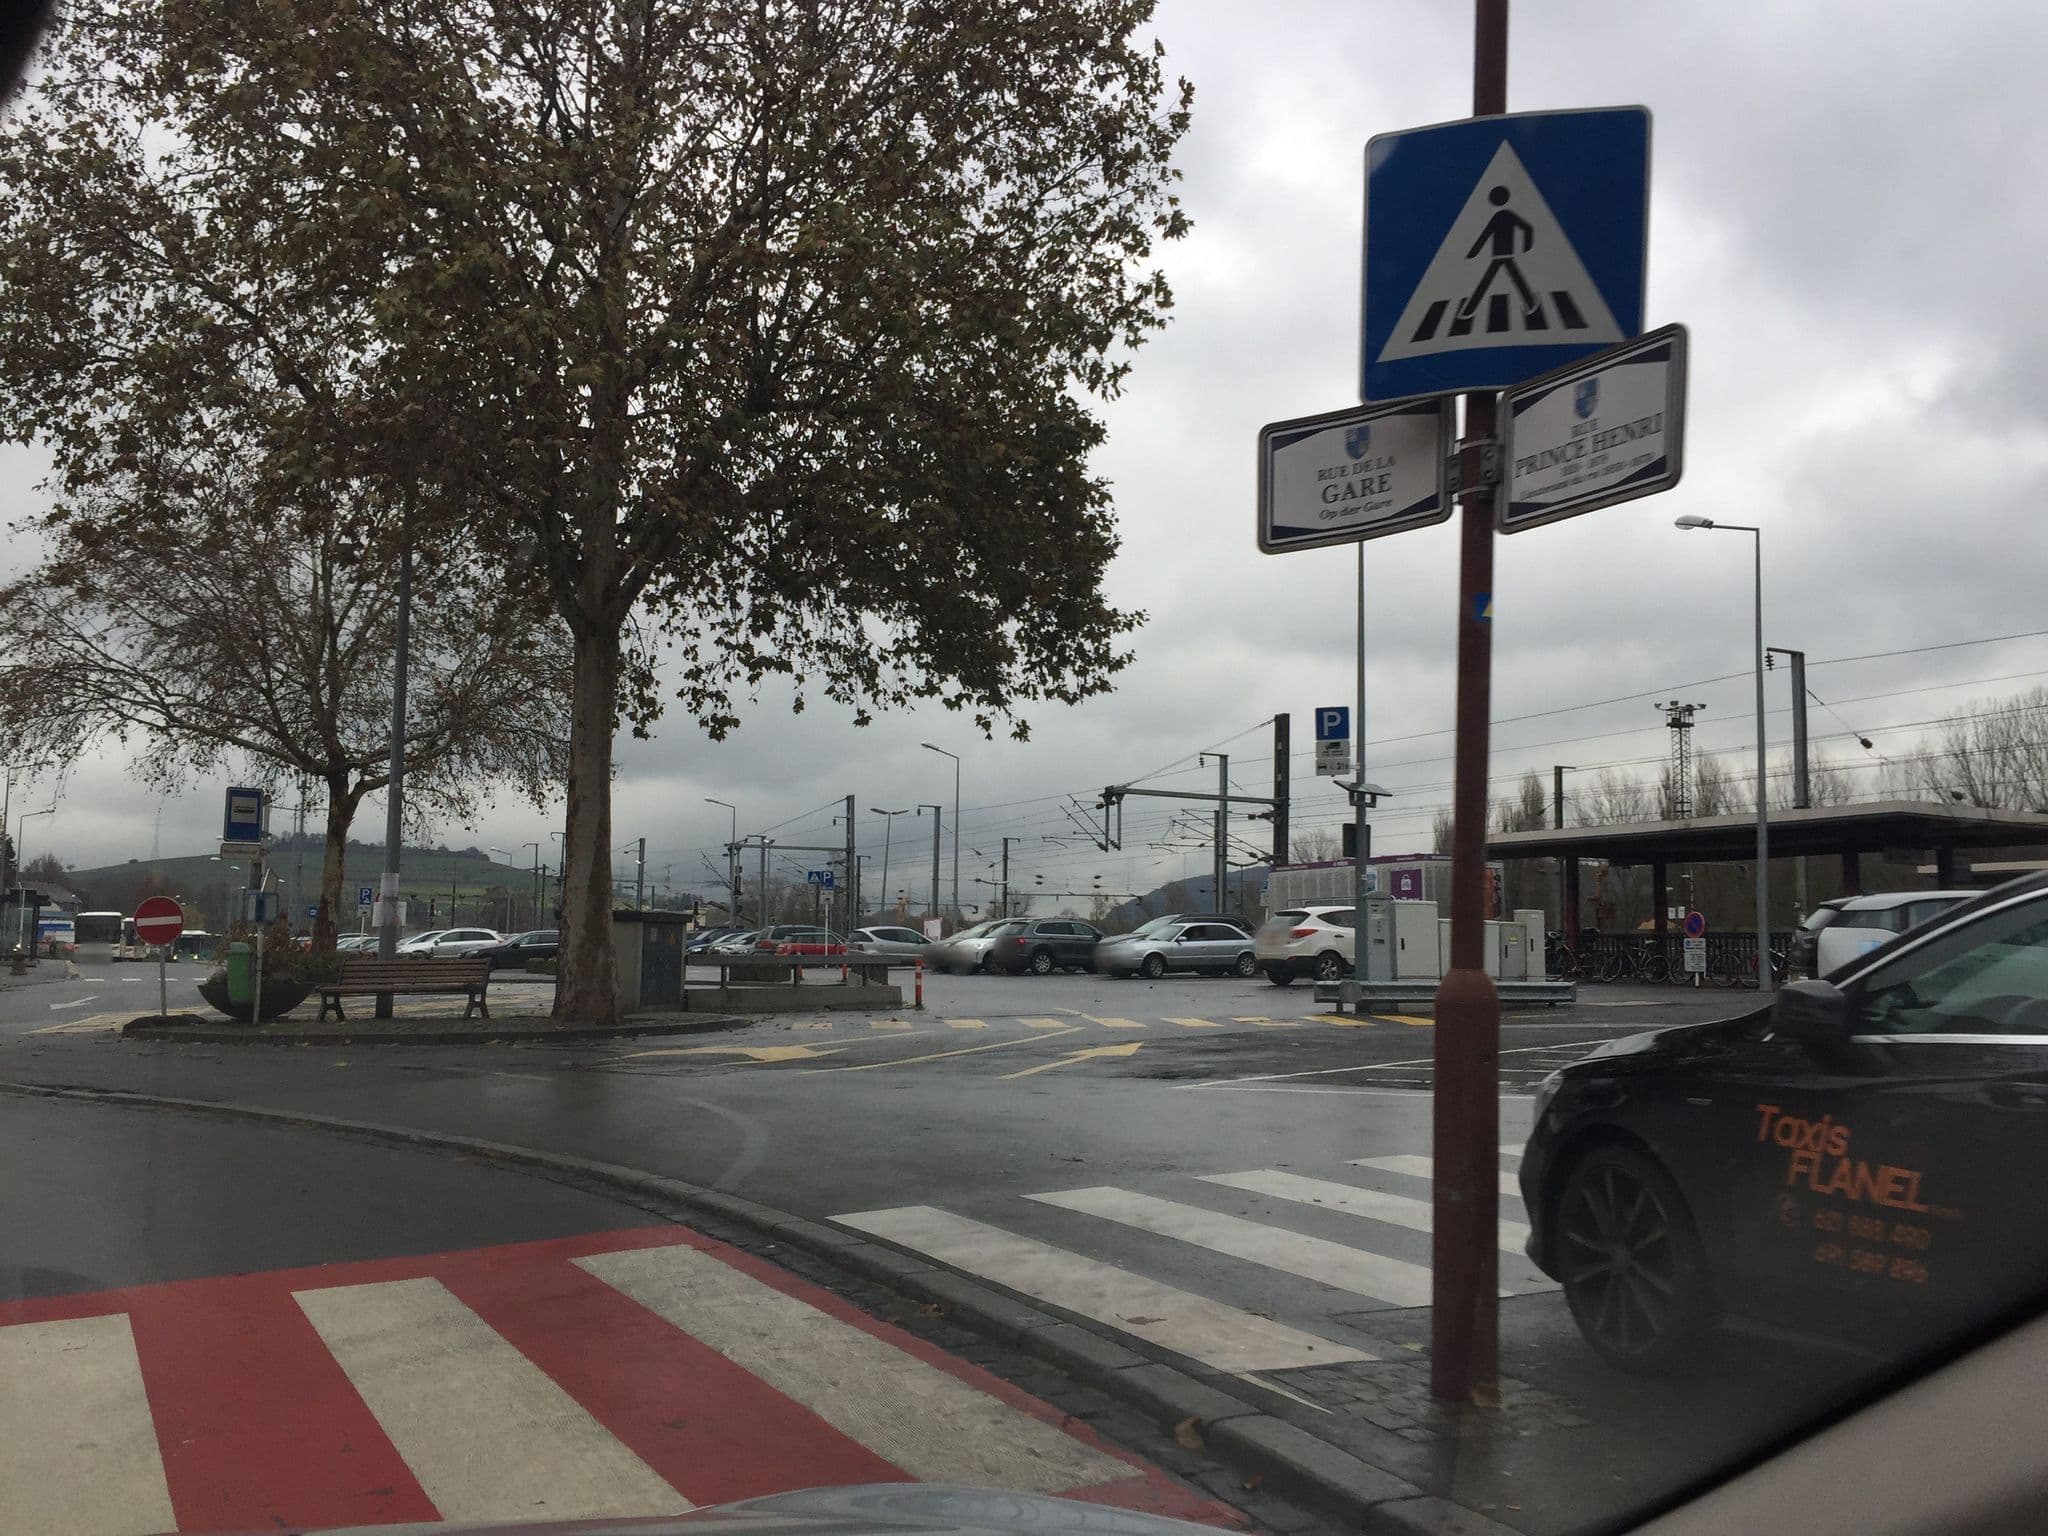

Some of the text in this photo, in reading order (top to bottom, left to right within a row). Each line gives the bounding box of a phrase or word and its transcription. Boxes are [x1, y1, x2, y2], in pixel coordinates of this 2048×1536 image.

[1513, 438, 1588, 479] PRINCE
[1591, 412, 1663, 453] HENRI
[1317, 456, 1396, 481] RUE DE LA
[1321, 473, 1393, 504] GARE
[1323, 711, 1341, 736] P
[1756, 1104, 1850, 1156] Taxis
[1788, 1149, 1950, 1218] FLANEL
